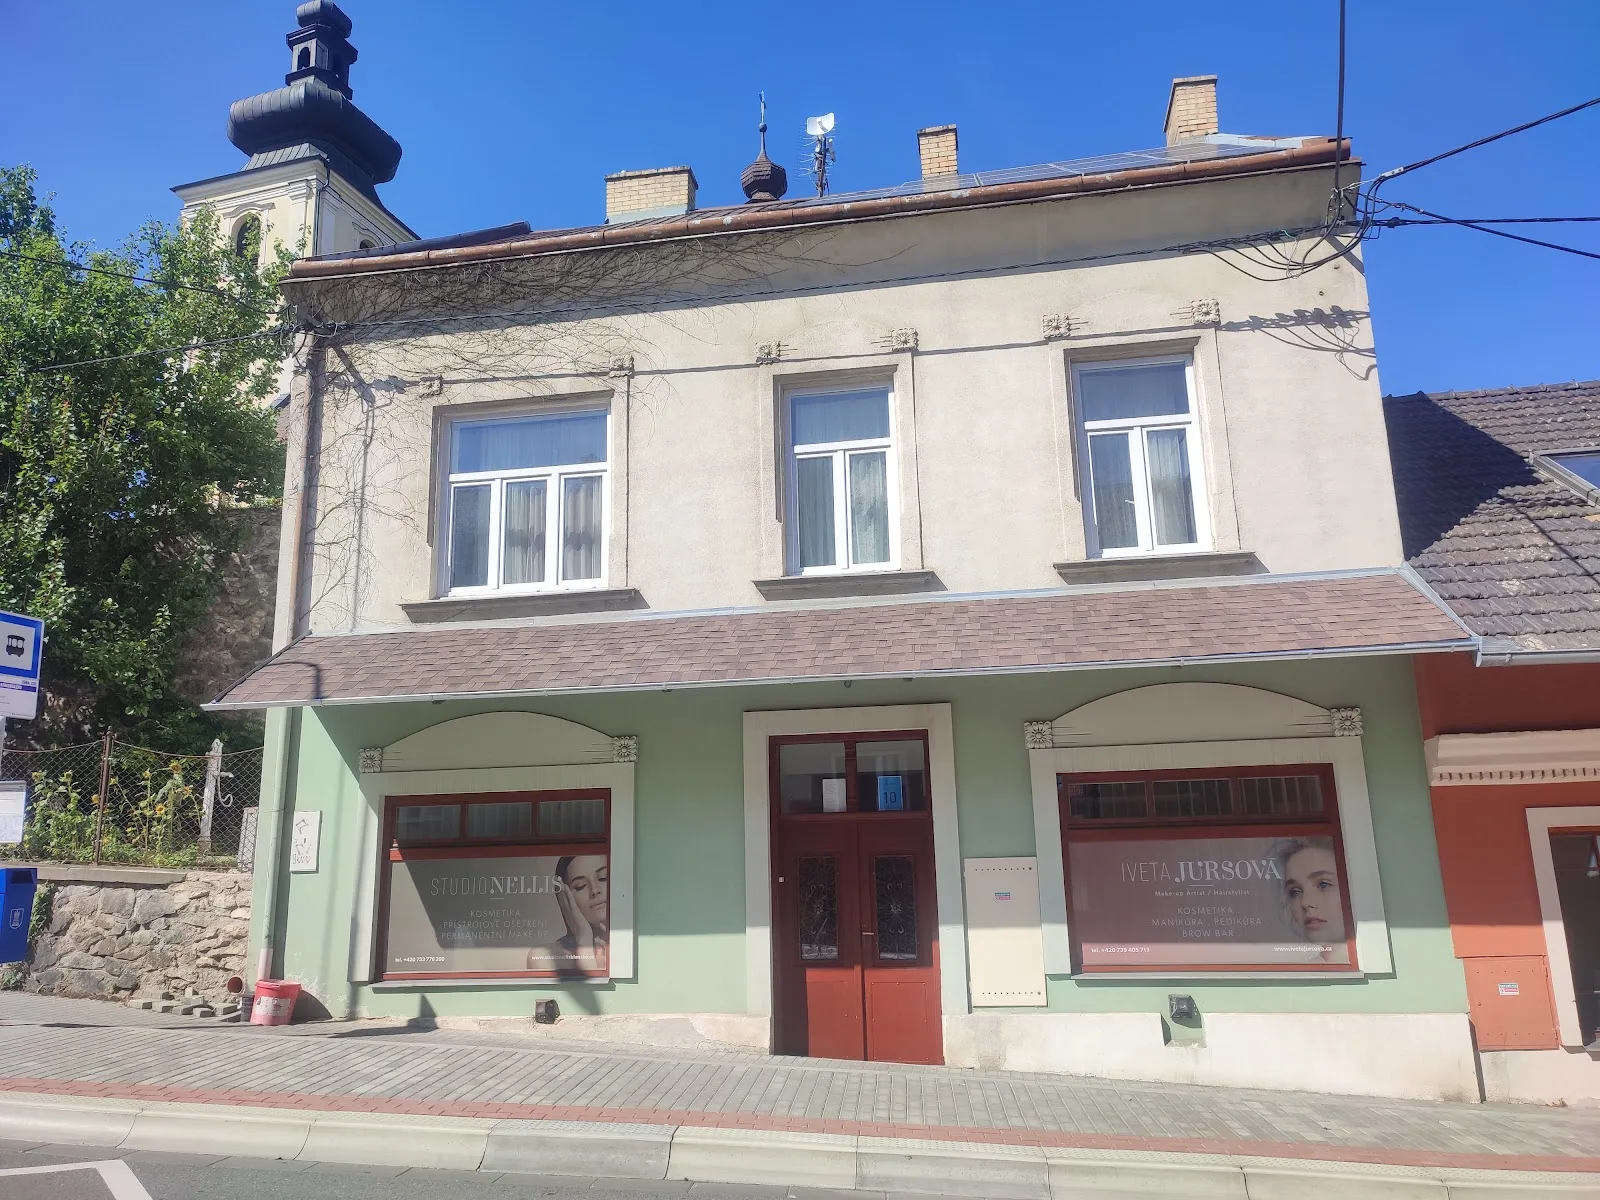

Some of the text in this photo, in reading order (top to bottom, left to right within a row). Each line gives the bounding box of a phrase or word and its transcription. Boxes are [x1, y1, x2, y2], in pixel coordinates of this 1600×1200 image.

[883, 791, 897, 804] 10
[1121, 857, 1283, 883] IVETA JURSOVÁ
[1154, 890, 1184, 898] Make-up
[1186, 889, 1206, 897] Artist
[1213, 888, 1251, 897] Hairstylist
[470, 909, 521, 918] KOSMETIKA
[1177, 906, 1234, 915] KOSMETIKA
[1182, 929, 1234, 938] BROW BAR
